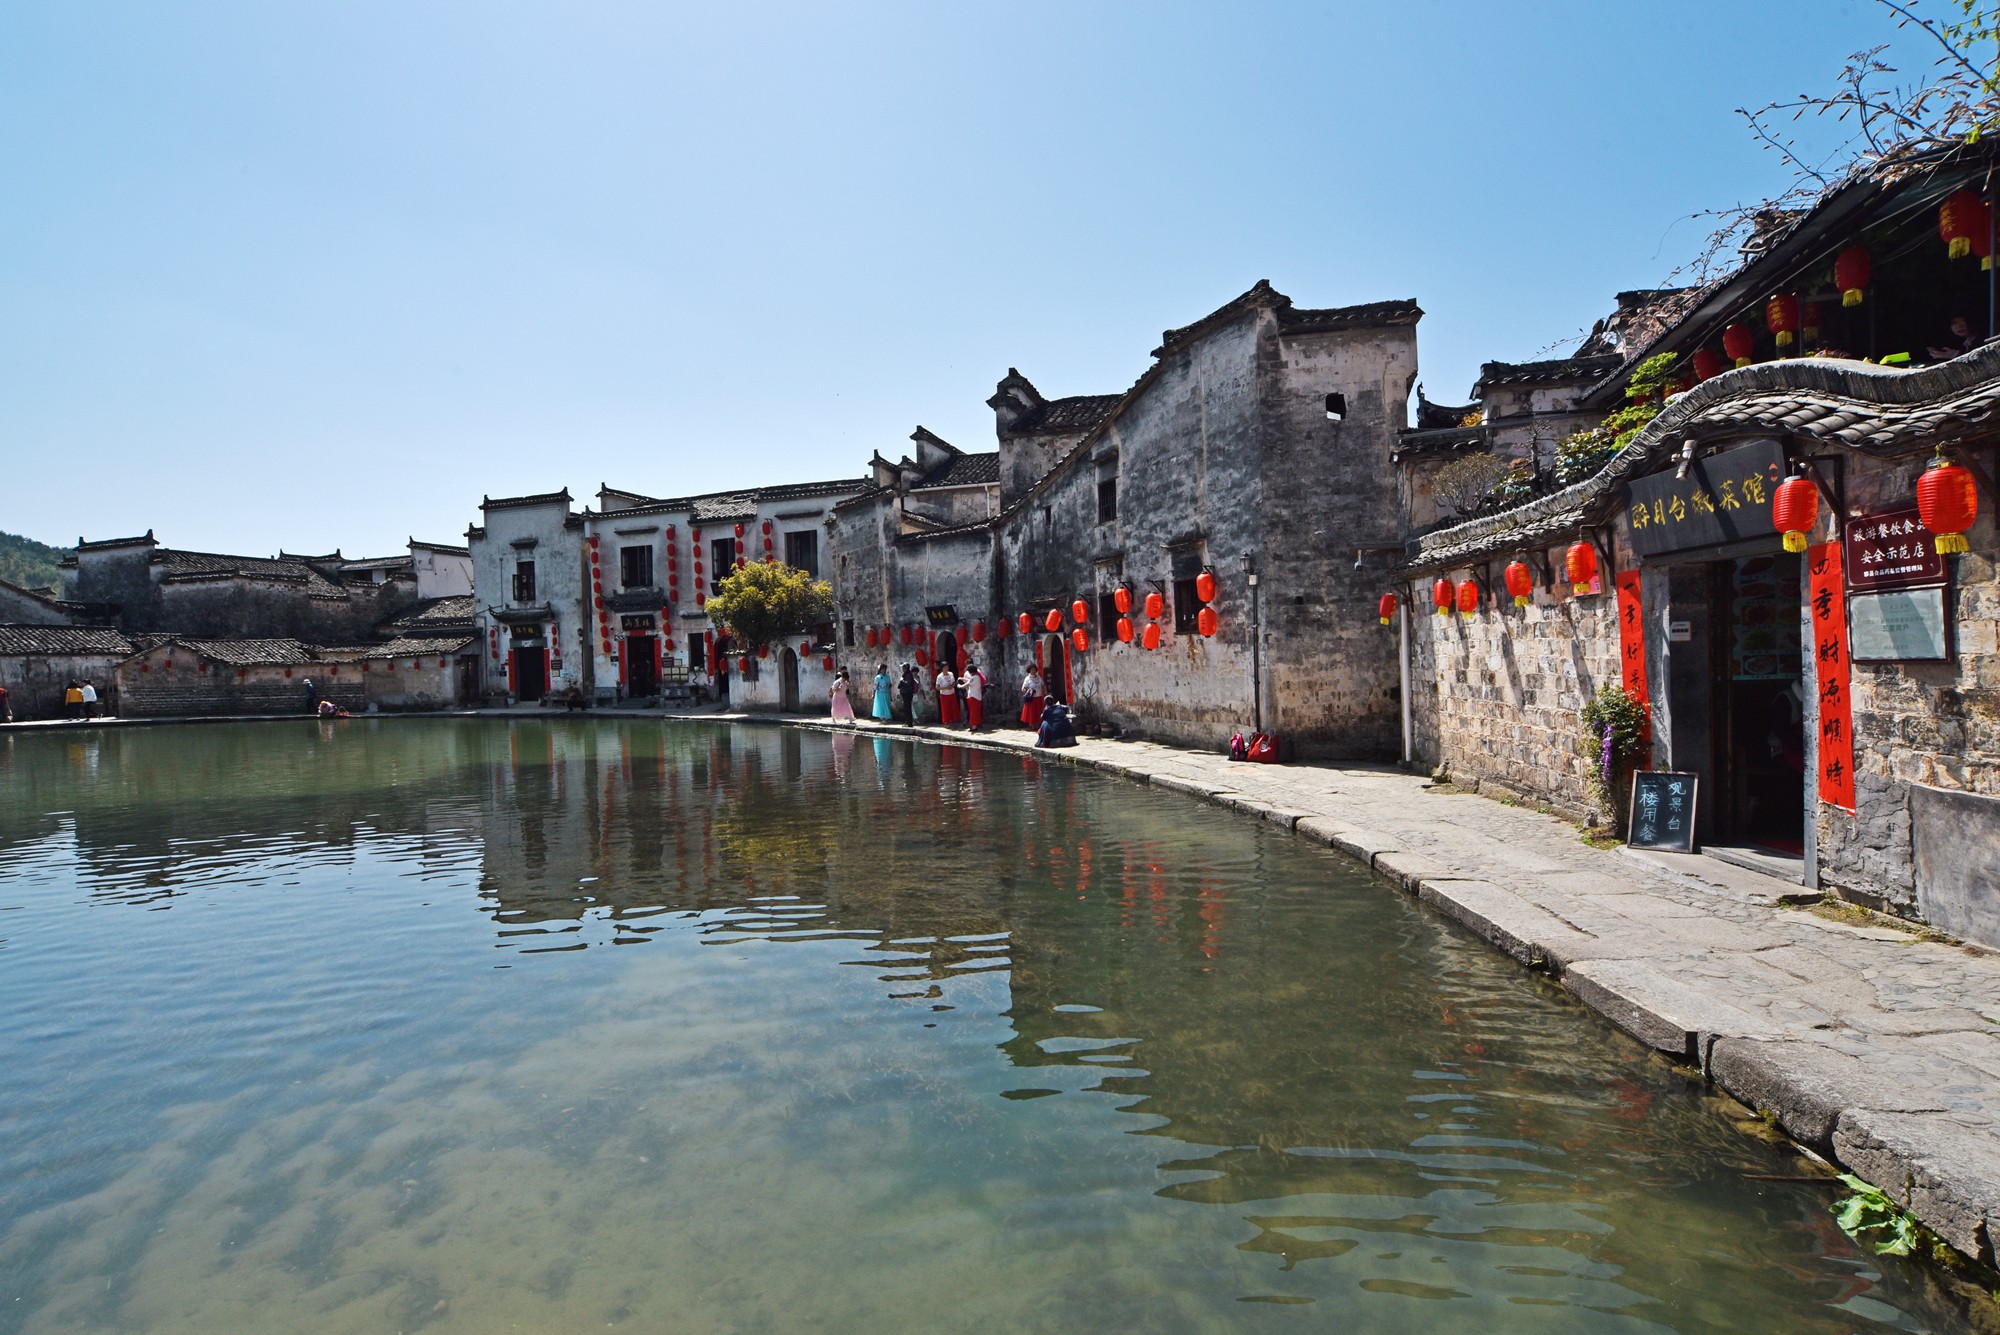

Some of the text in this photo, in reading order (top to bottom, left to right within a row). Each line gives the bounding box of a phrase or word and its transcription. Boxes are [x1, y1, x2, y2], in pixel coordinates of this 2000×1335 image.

[1853, 519, 1927, 542] 旅游餐饮食品
[1861, 542, 1925, 564] 安全示范店
[1639, 780, 1660, 841] 二楼用餐
[1668, 781, 1687, 830] 观景台
